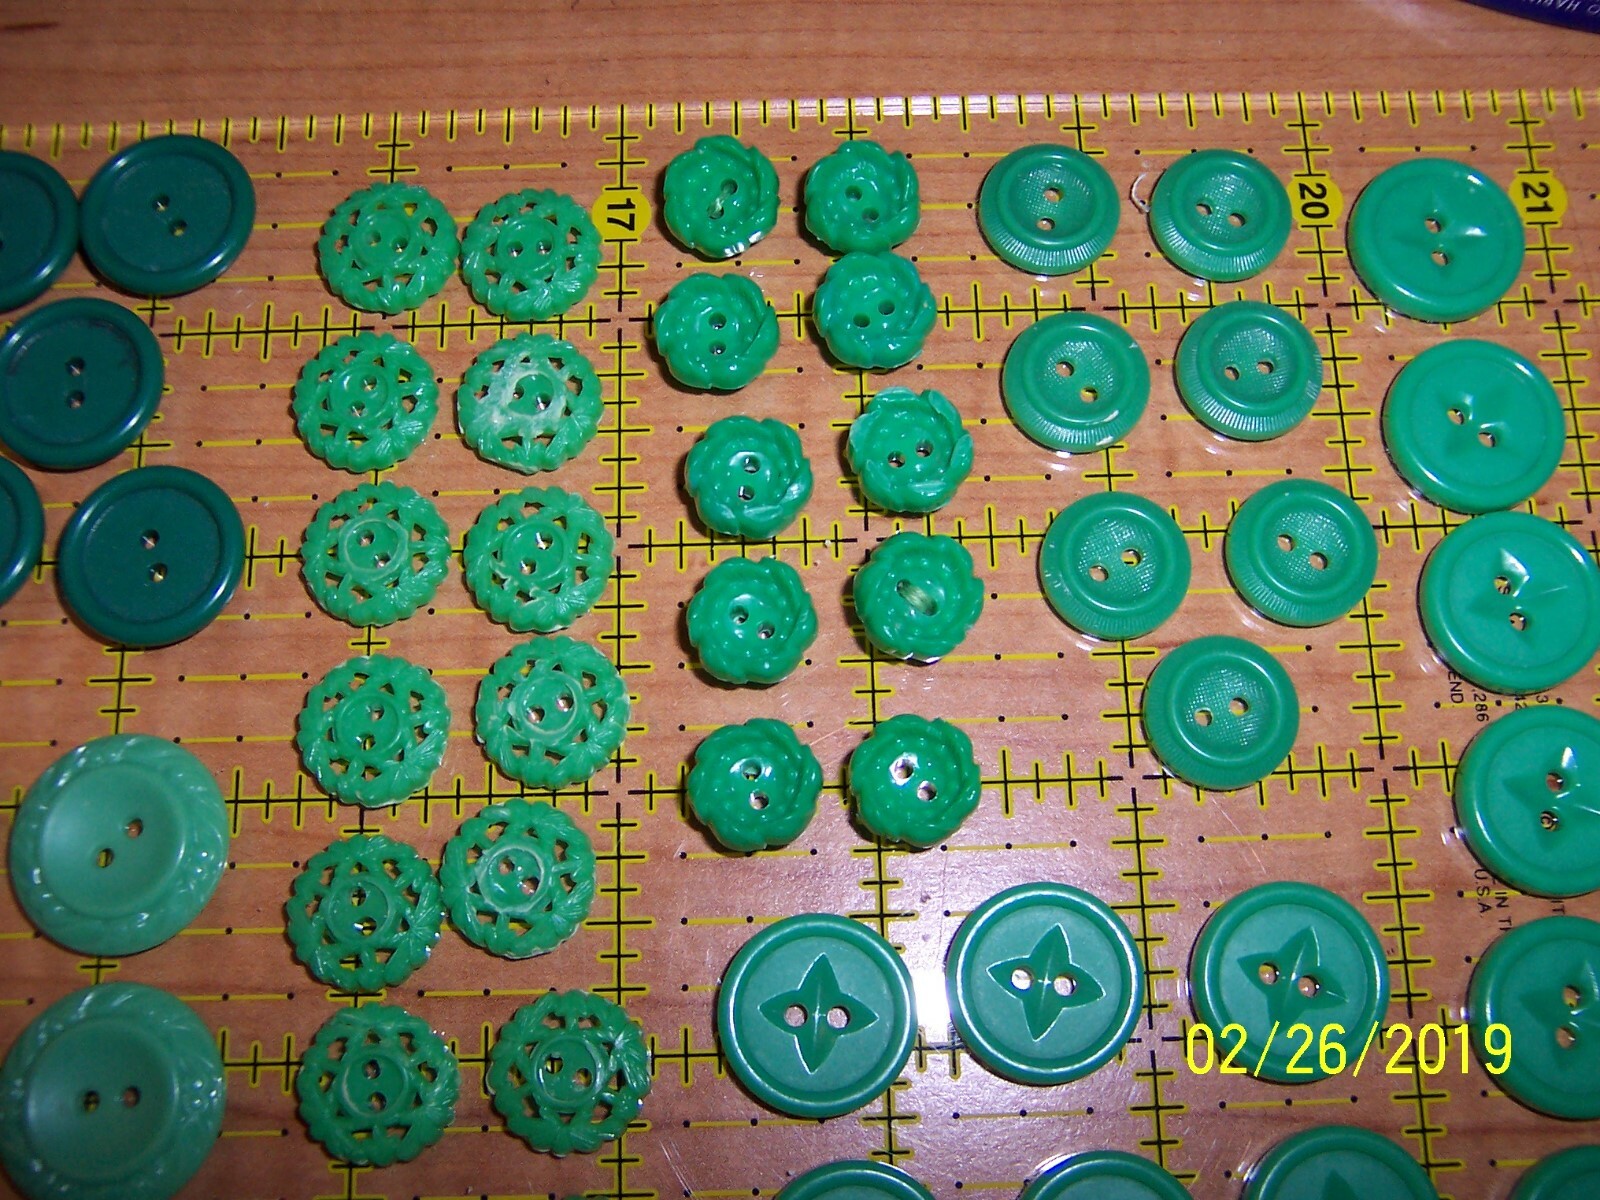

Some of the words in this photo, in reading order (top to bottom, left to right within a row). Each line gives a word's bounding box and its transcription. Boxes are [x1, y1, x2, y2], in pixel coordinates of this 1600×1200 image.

[607, 197, 636, 232] 17
[1299, 183, 1330, 219] 20
[1522, 181, 1554, 213] 21
[1474, 868, 1492, 918] U.S.A.
[1495, 891, 1510, 908] IN
